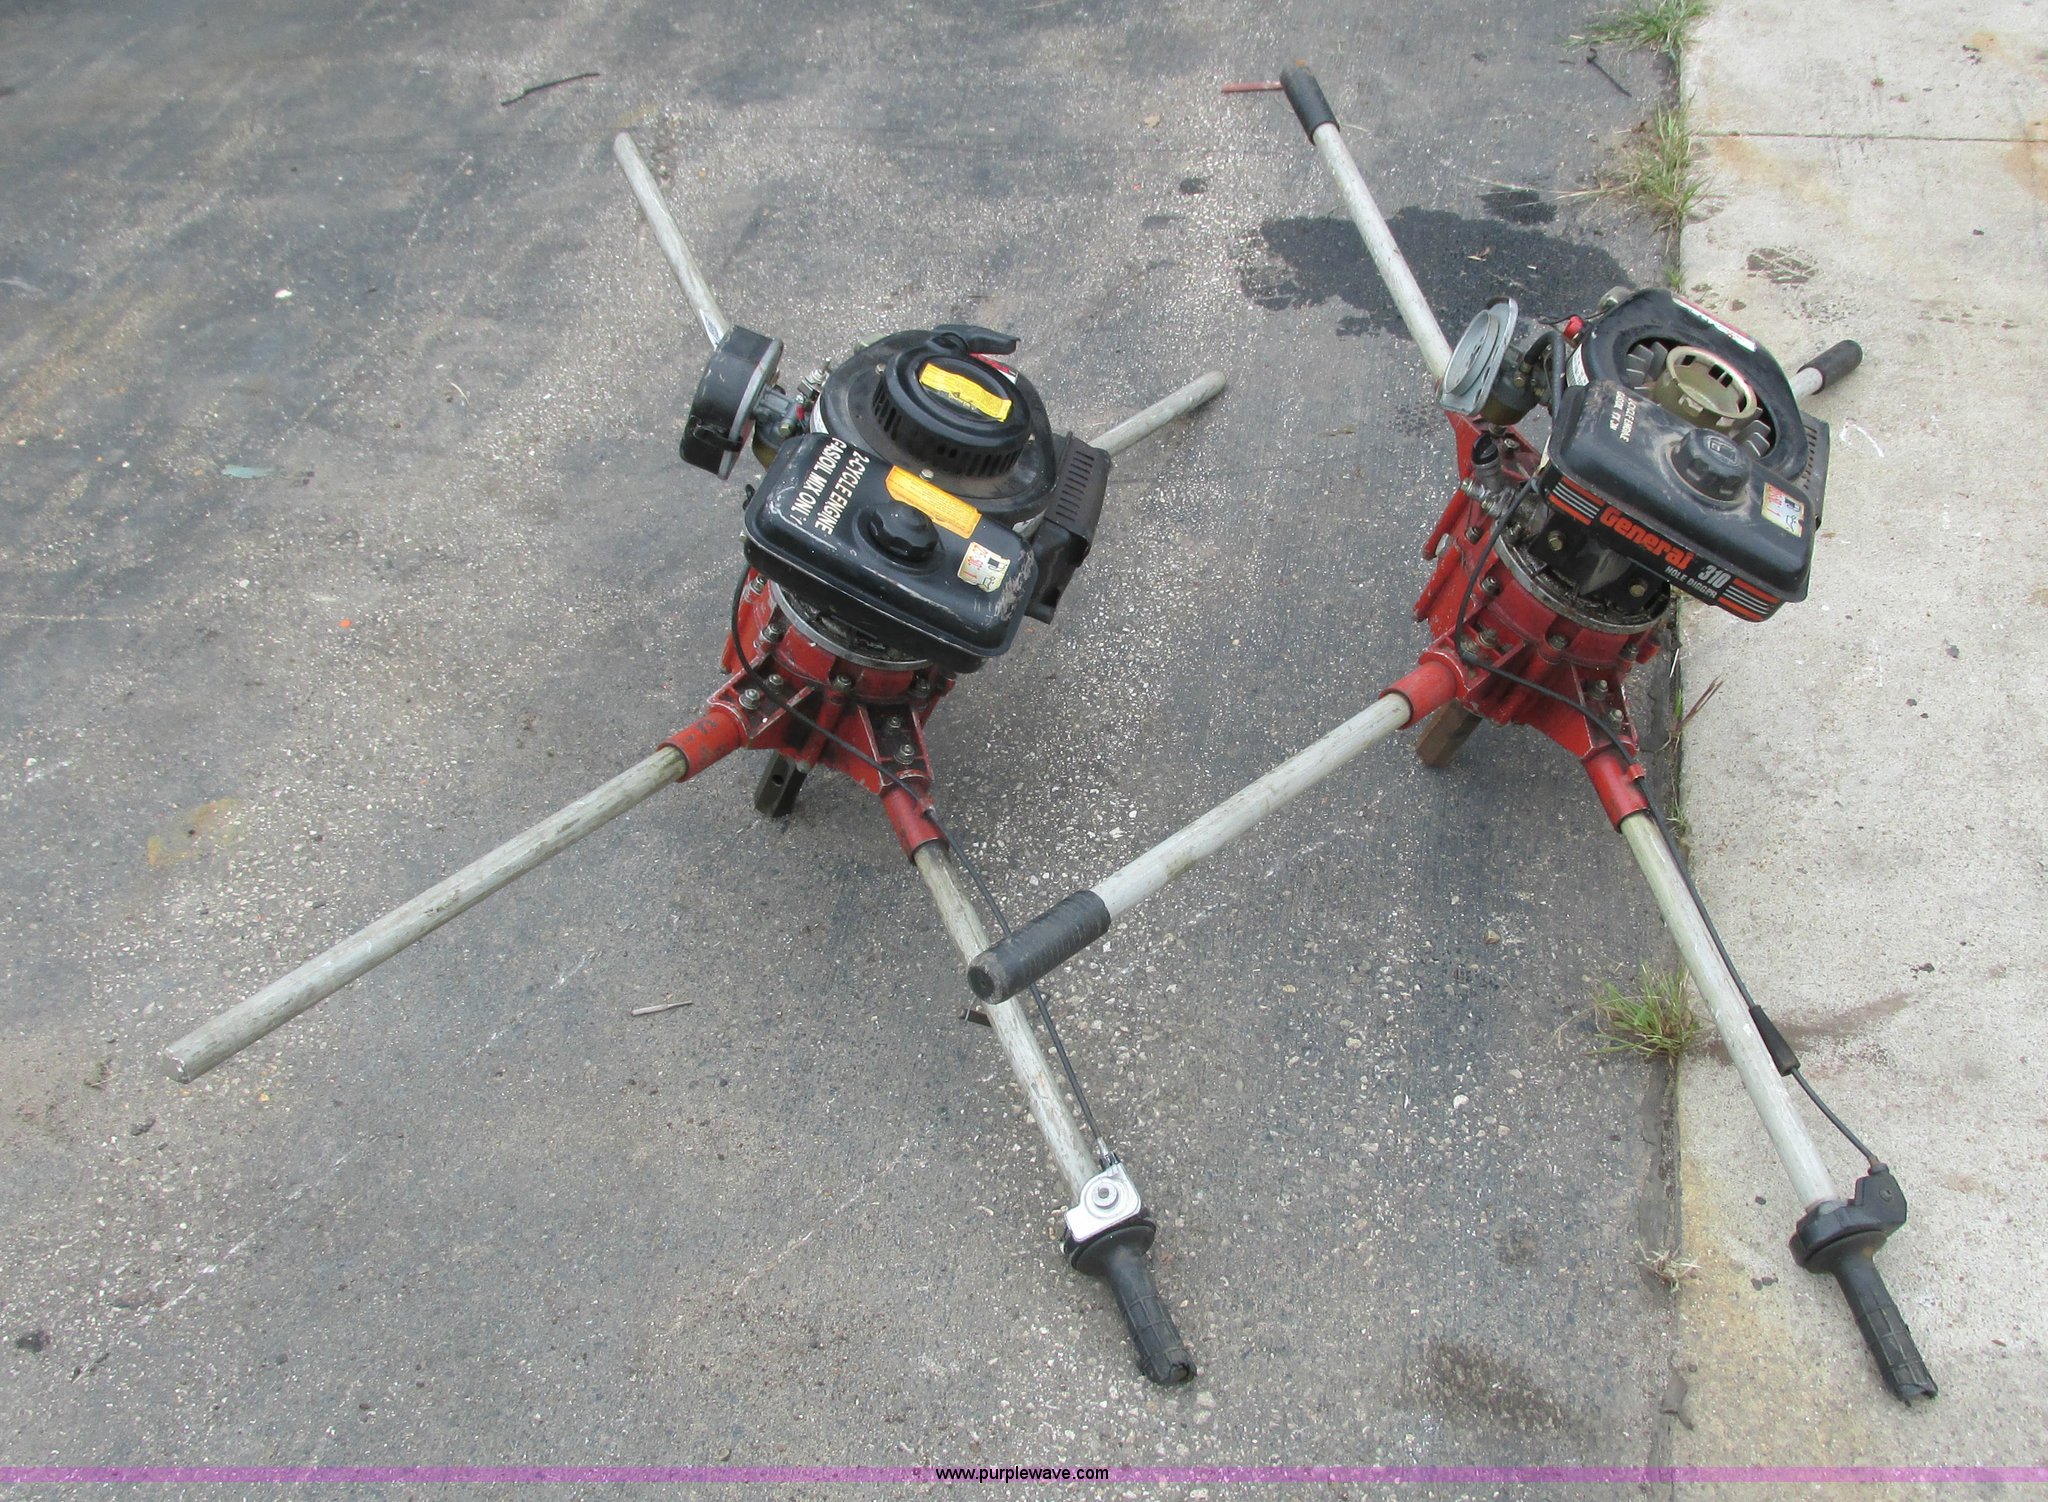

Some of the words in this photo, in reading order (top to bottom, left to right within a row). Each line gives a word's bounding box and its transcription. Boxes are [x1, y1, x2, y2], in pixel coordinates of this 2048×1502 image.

[803, 471, 827, 497] MIX
[834, 451, 870, 497] 2-CYCLE
[814, 490, 849, 535] ENGINE
[1664, 565, 1687, 583] HOLE
[1686, 577, 1718, 599] DIGGER
[1697, 564, 1731, 589] 310
